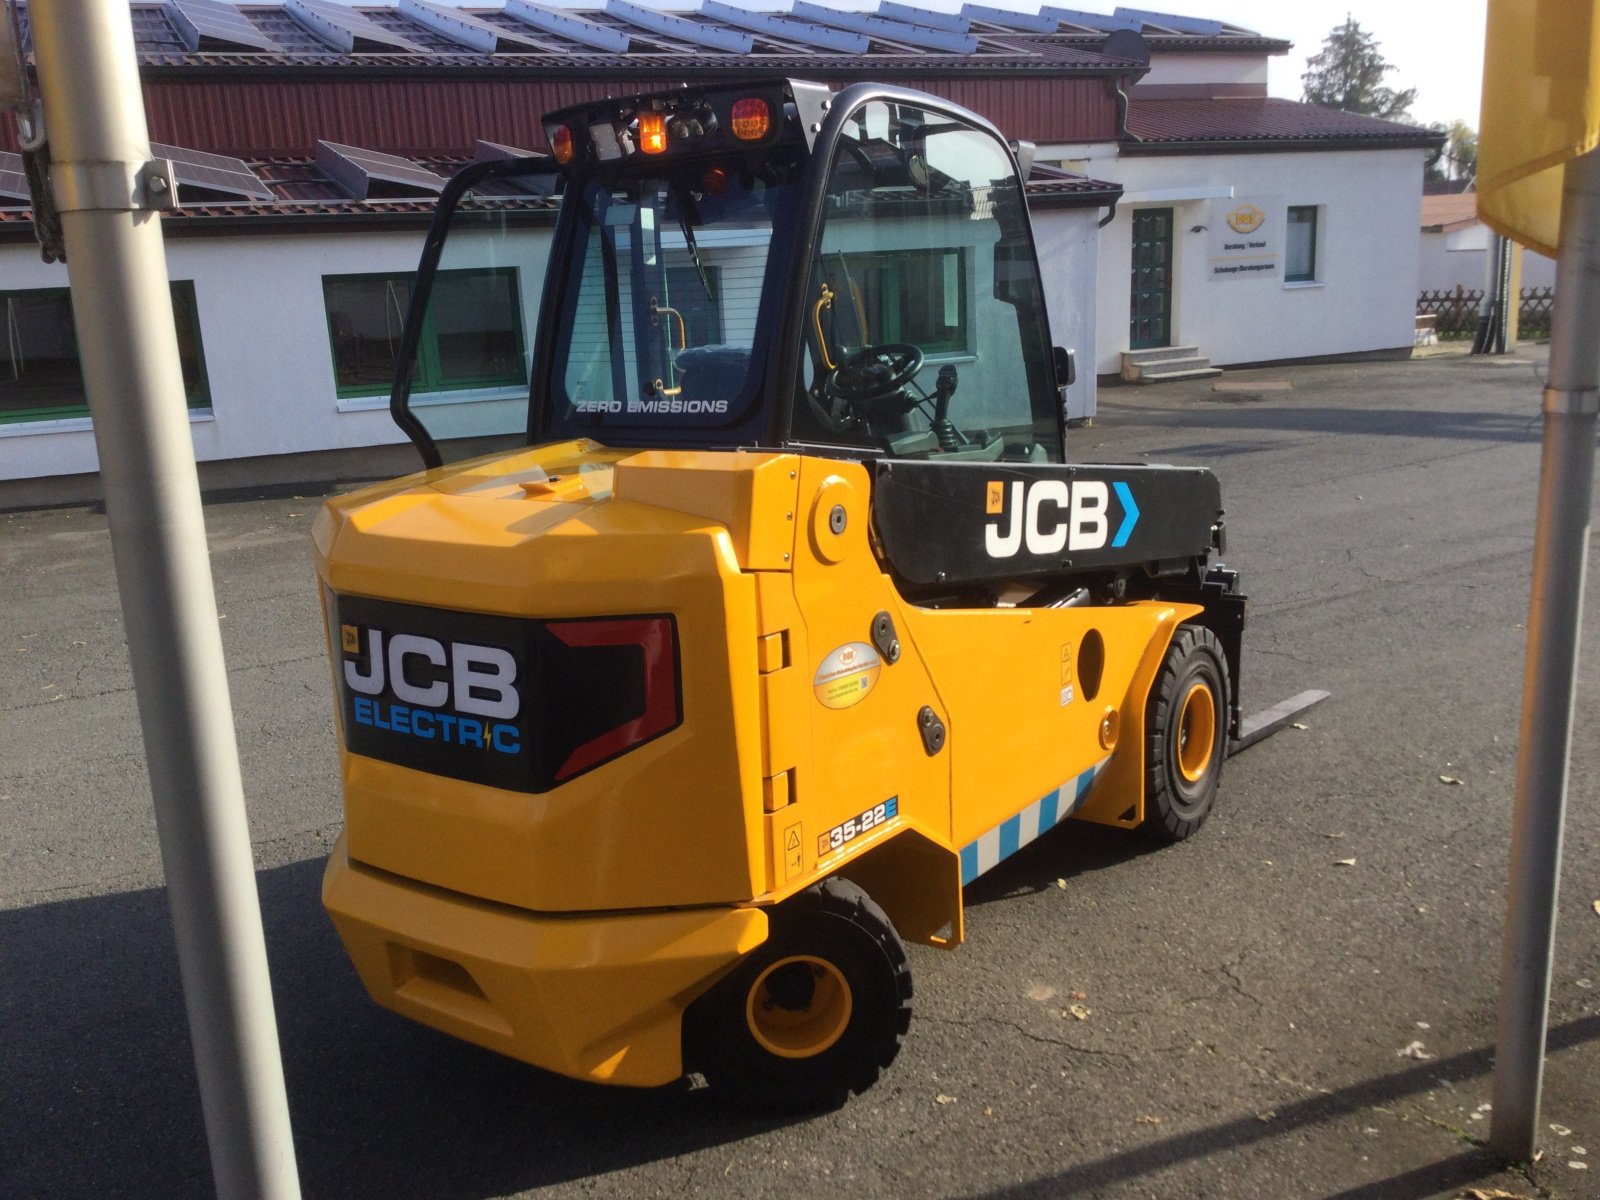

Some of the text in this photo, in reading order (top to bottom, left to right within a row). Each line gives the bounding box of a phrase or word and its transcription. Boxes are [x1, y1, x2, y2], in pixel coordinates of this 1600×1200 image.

[576, 400, 729, 413] ZERO EMISSIONS
[985, 480, 1109, 559] JCB
[343, 629, 520, 720] JCB
[830, 797, 897, 849] 35-22E
